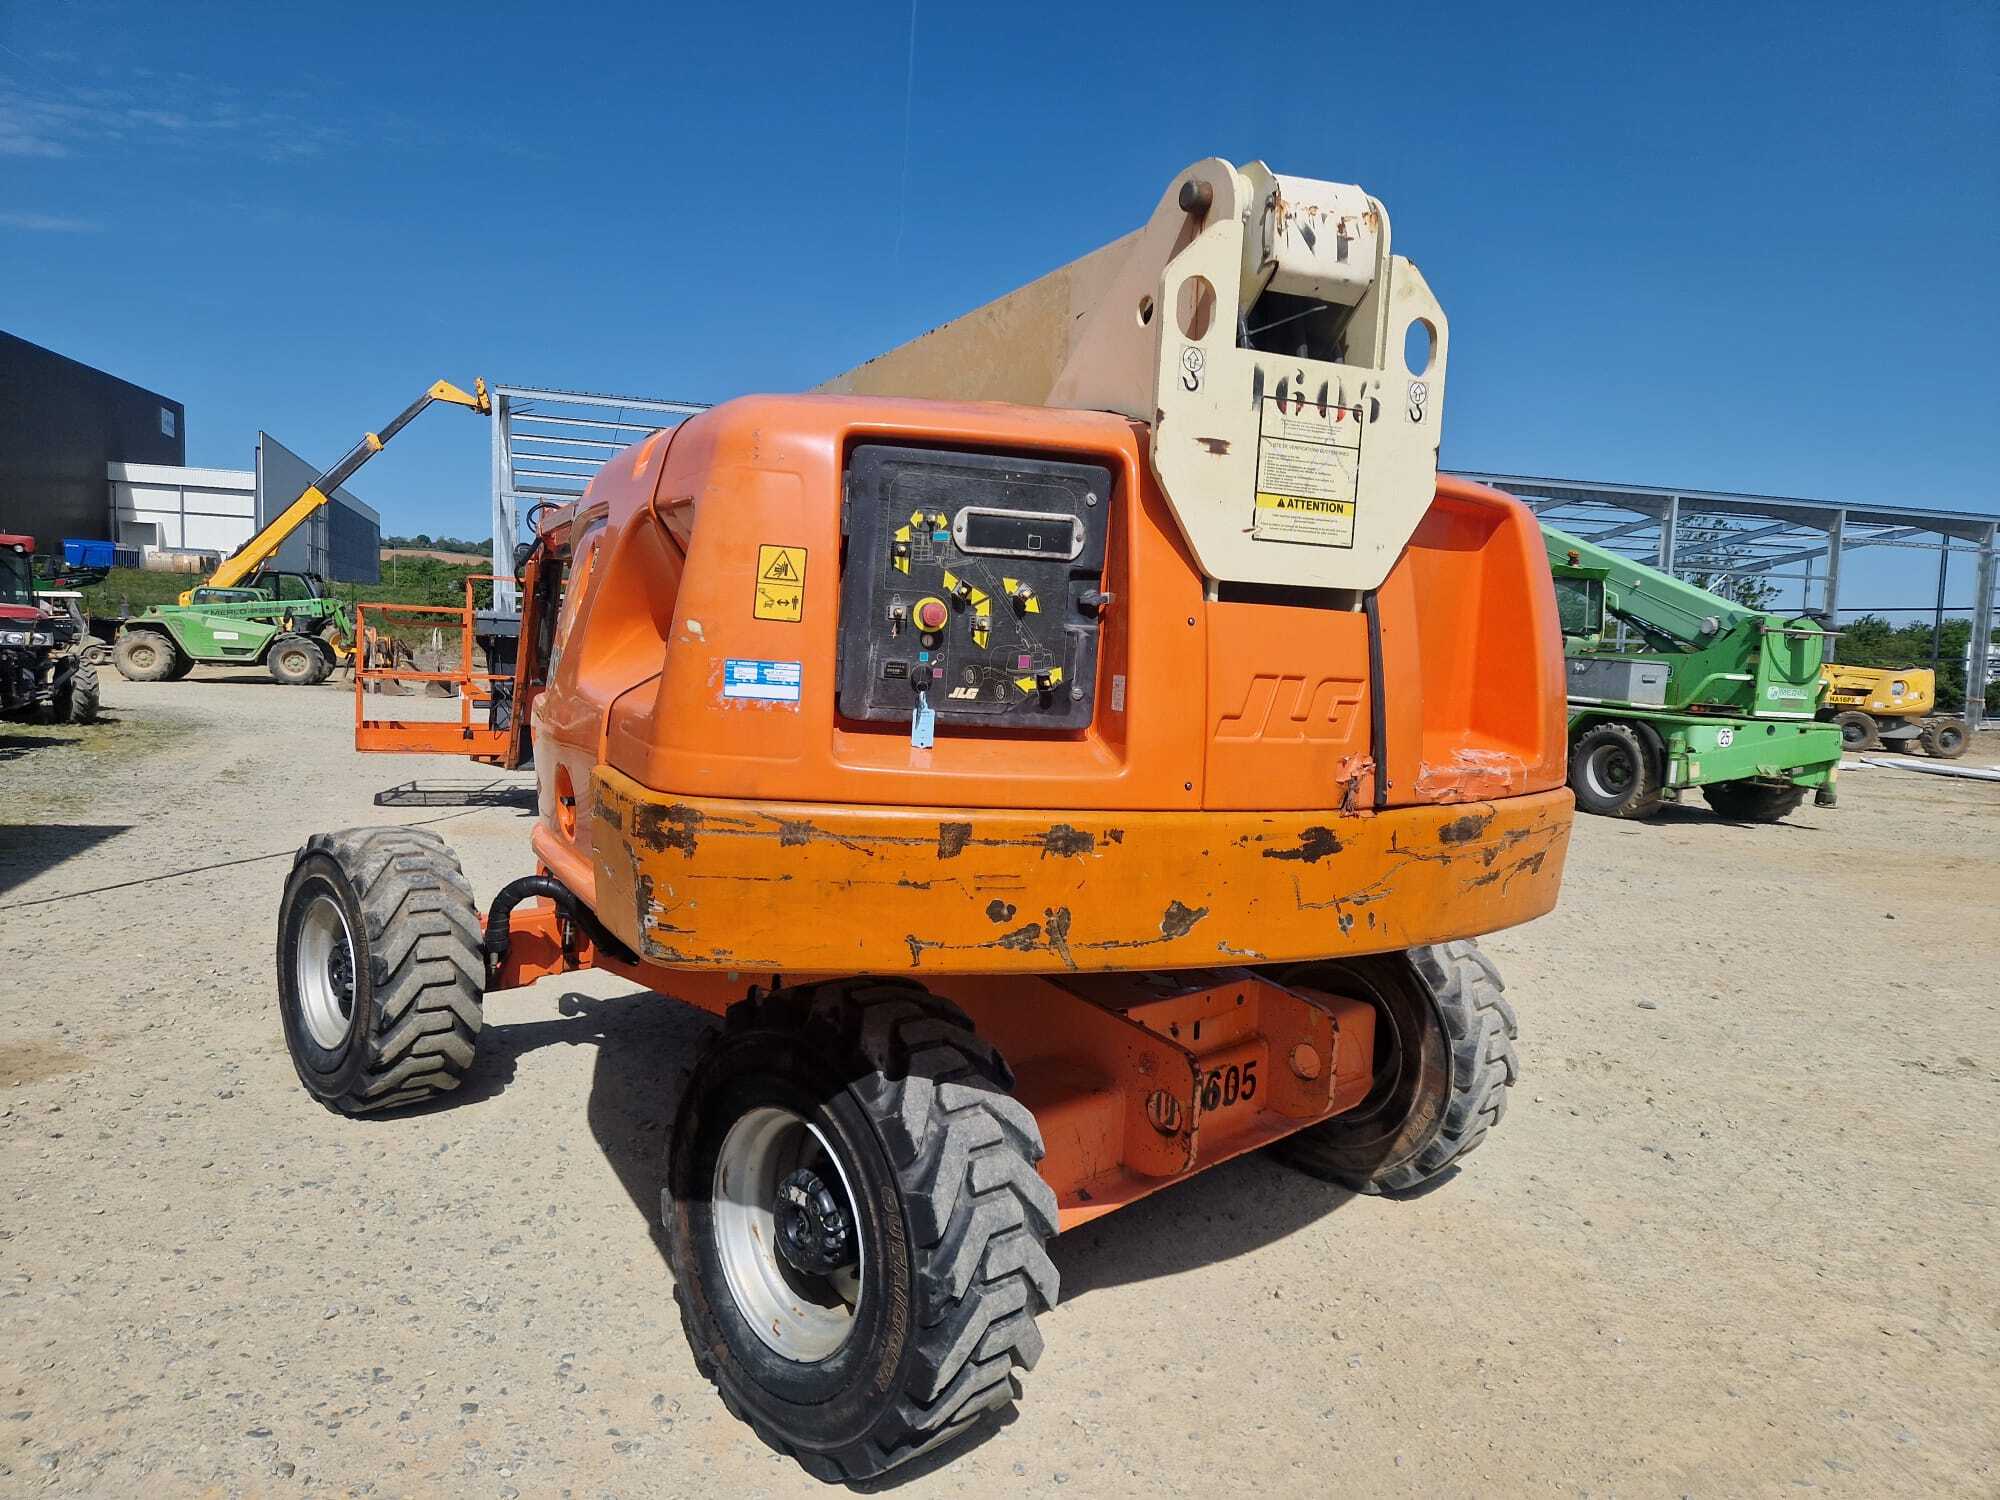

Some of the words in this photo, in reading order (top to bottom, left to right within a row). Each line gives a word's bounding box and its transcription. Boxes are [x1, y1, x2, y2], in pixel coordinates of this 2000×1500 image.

[1287, 498, 1344, 514] ATTENTION
[948, 686, 979, 699] JLG
[1214, 673, 1367, 742] JLG
[1720, 730, 1730, 745] 25
